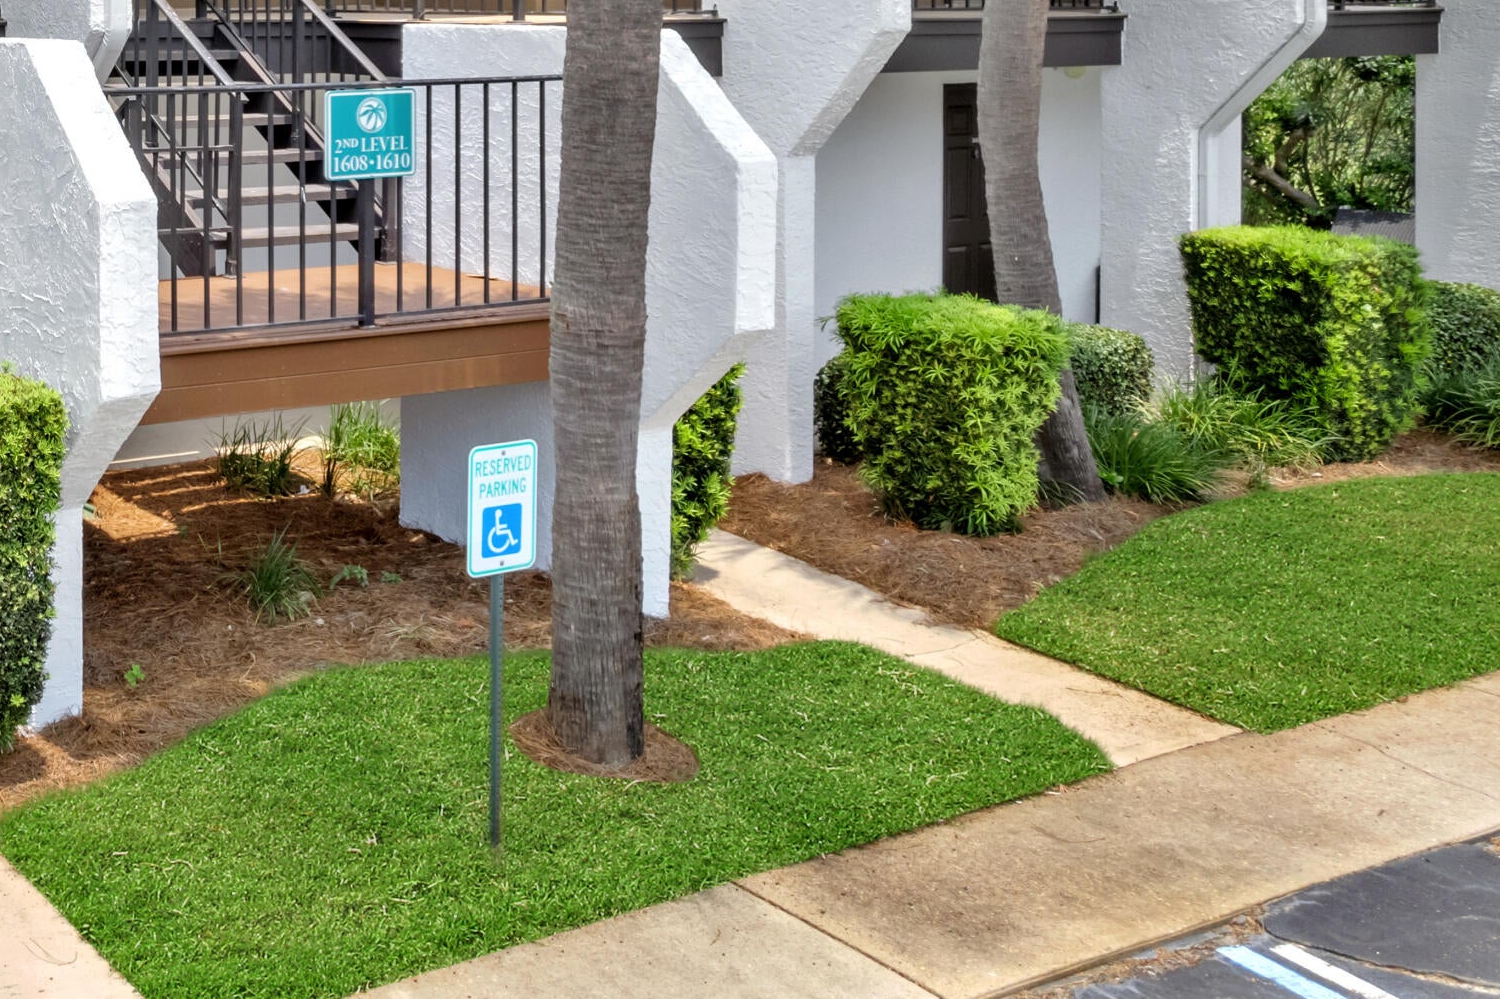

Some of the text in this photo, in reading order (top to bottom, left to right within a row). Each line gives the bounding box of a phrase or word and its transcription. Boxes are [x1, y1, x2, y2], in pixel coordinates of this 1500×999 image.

[335, 136, 408, 154] 2ND LEVEL
[475, 455, 531, 477] RESERVED
[479, 478, 526, 499] PARKING
